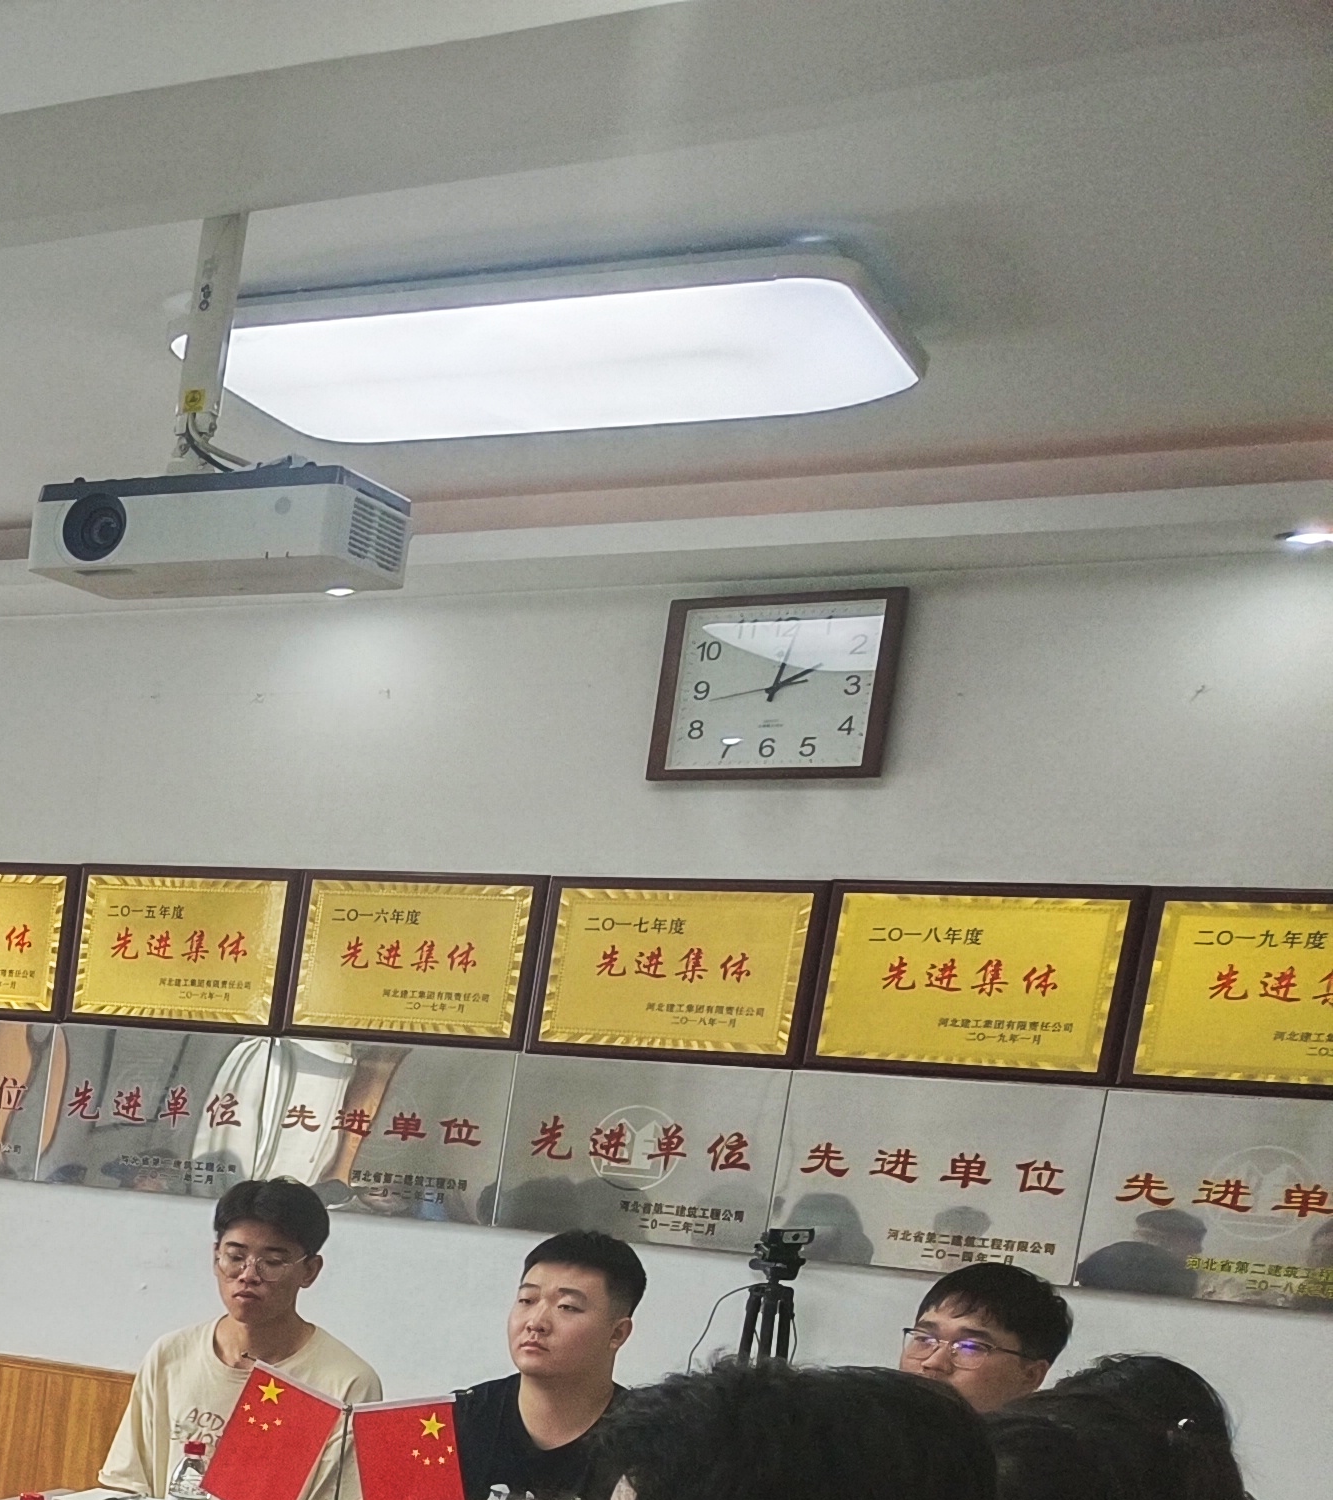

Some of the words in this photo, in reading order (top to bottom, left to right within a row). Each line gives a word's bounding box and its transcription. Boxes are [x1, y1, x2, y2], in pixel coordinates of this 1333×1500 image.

[696, 640, 722, 662] 10
[848, 634, 868, 655] 2
[693, 680, 711, 701] 9
[843, 674, 862, 696] 3
[687, 719, 704, 740] 8
[837, 715, 855, 736] 4
[758, 737, 776, 758] 6
[799, 736, 817, 757] 5
[107, 904, 185, 920] 二〇一五年度
[331, 908, 422, 926] 二〇一六年度
[583, 916, 687, 936] 二〇一七年度
[868, 926, 985, 947] 二〇一八年度
[110, 926, 249, 963] 先进集体
[1193, 929, 1330, 950] 二〇一九年度
[340, 935, 479, 974] 先进集体
[596, 944, 753, 984] 先进集体
[881, 955, 1060, 998] 先进集体
[66, 1080, 243, 1129] 先进单位
[280, 1104, 483, 1149] 先进单位
[531, 1115, 753, 1173] 先进单位
[799, 1143, 1068, 1197] 先进单位
[619, 1199, 745, 1223] 河北省第二建筑工程公司
[886, 1228, 1057, 1256] 河北省第二建筑工程有限公司
